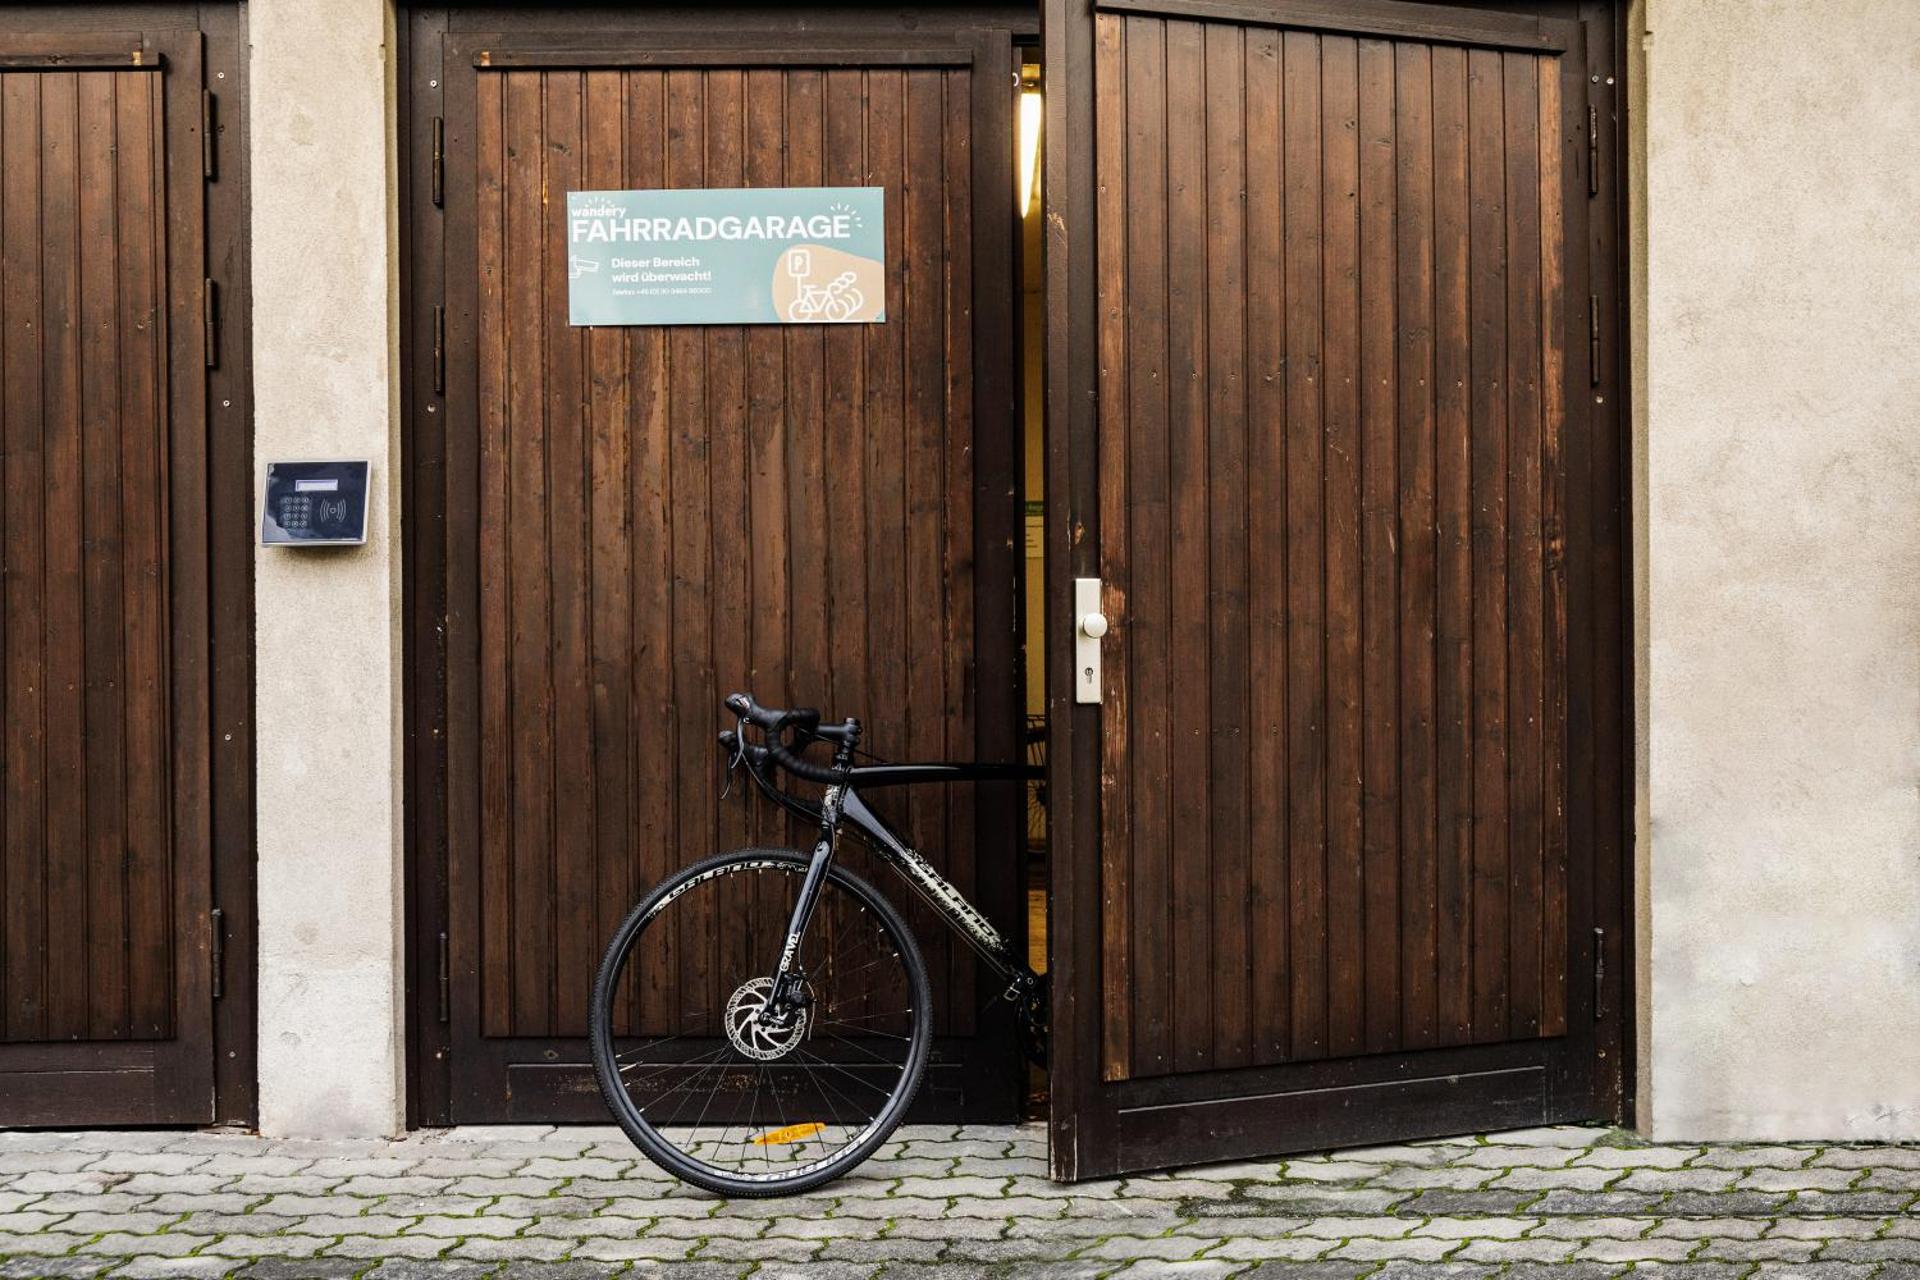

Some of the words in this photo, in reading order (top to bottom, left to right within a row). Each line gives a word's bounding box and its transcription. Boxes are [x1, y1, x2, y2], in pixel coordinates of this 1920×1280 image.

[571, 204, 627, 219] wandery
[571, 214, 852, 243] FAHRRADGARAGE
[611, 257, 650, 269] Dieser
[652, 256, 700, 268] Bereich
[612, 271, 639, 283] wird
[641, 270, 712, 282] überwacht!
[779, 931, 801, 972] GRAVEL
